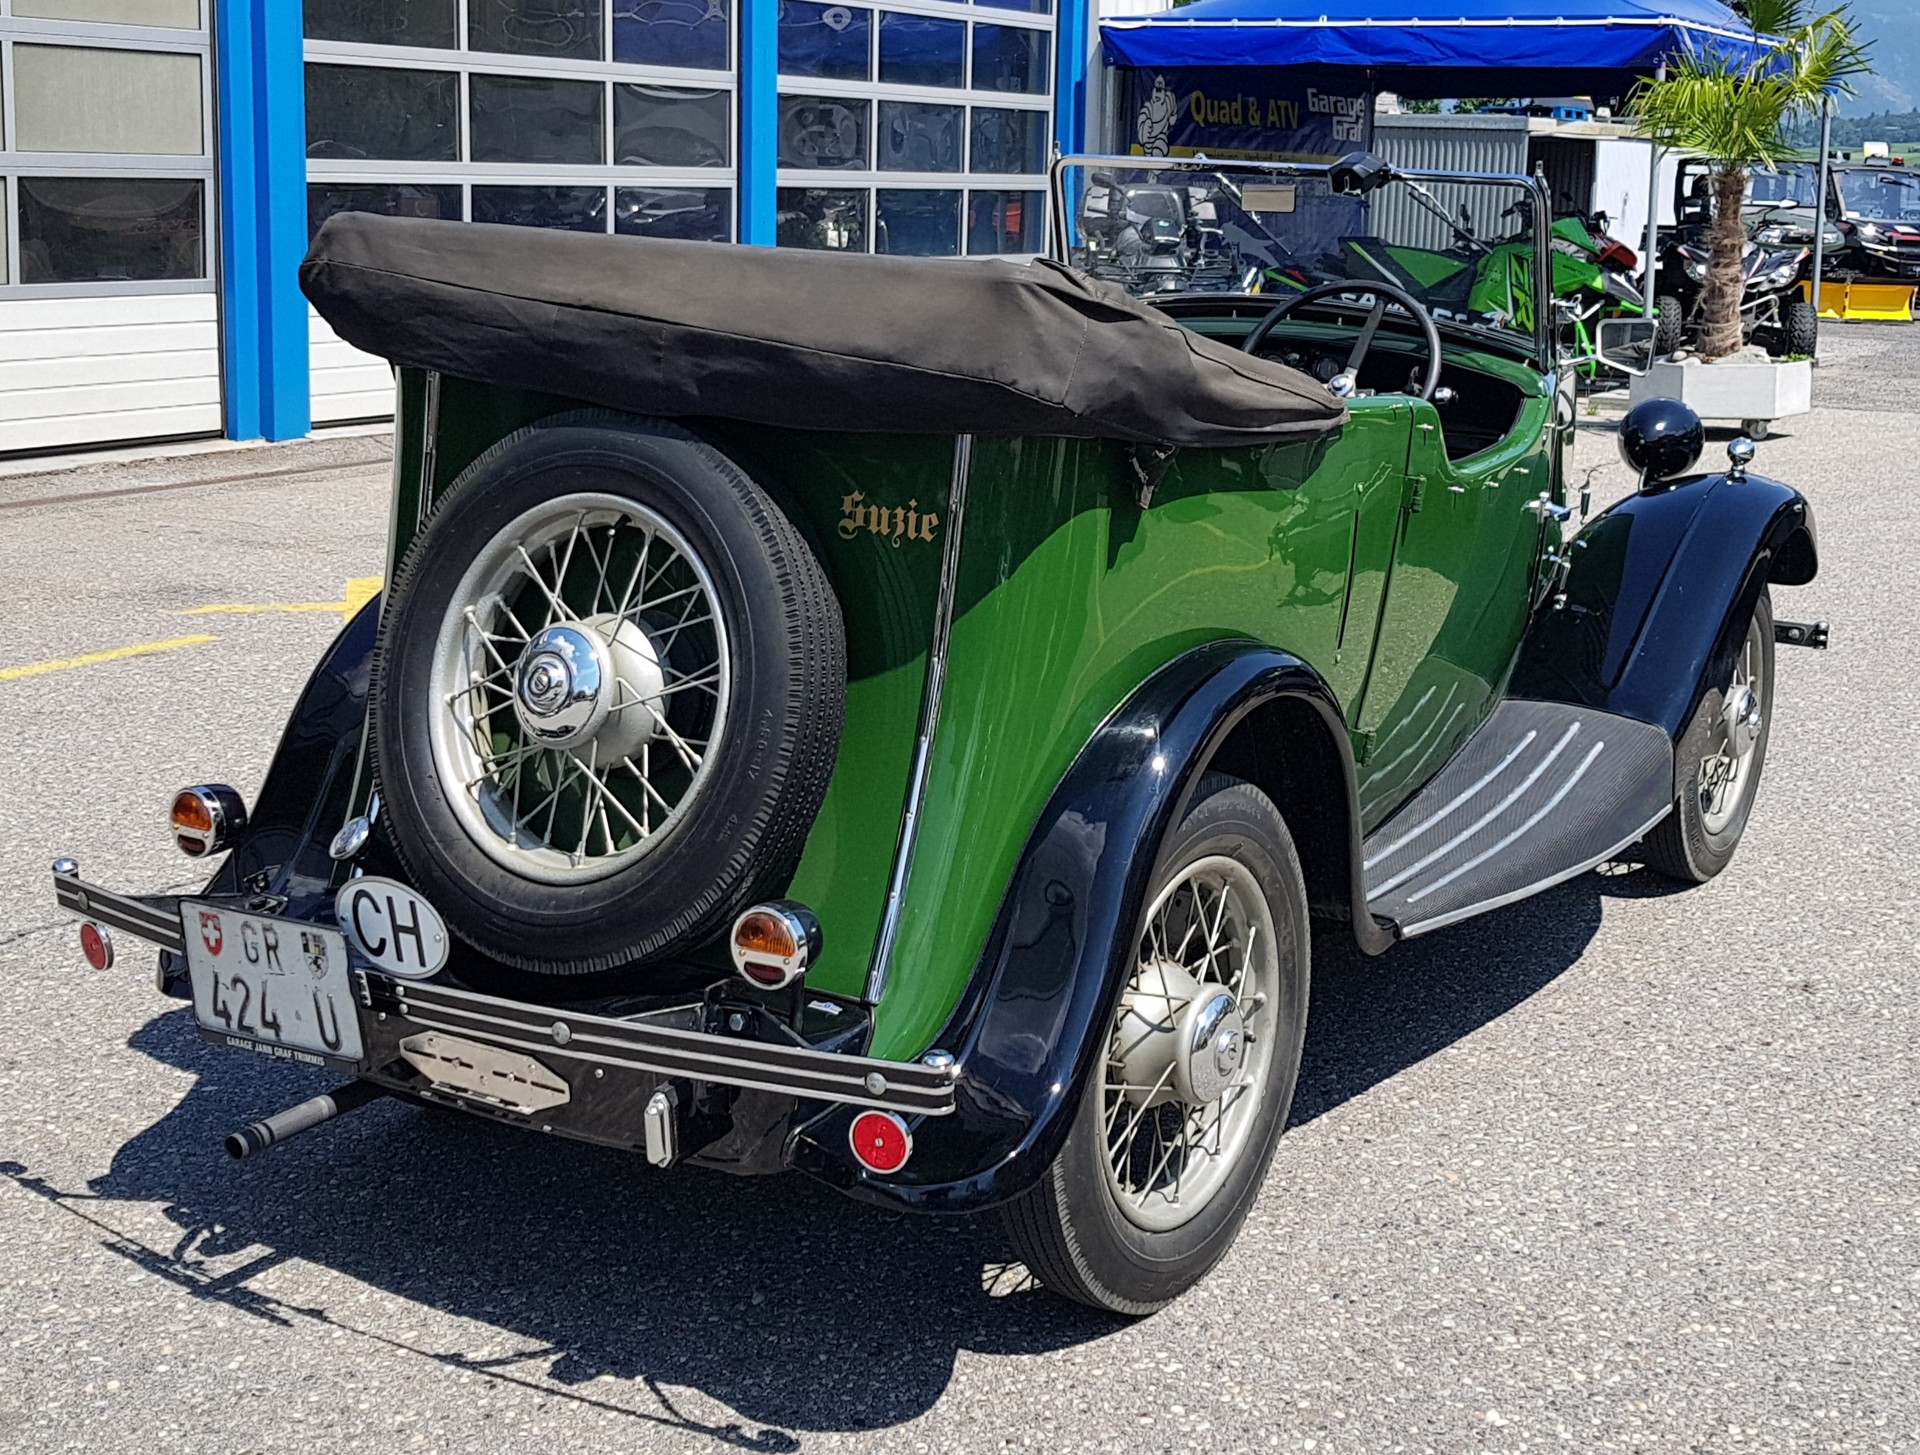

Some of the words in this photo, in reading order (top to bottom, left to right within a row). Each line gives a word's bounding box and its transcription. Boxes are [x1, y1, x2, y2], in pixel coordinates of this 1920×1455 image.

[1190, 90, 1242, 128] Quad
[1248, 96, 1261, 126] &
[1266, 99, 1299, 129] ATV
[1307, 87, 1365, 122] Garage
[1332, 116, 1364, 142] Graf
[837, 489, 940, 549] Suzie
[240, 920, 284, 972] GR
[352, 889, 427, 968] CH
[212, 971, 282, 1042] 424
[312, 988, 342, 1052] U
[226, 1036, 253, 1051] GARAGE
[274, 1047, 293, 1059] GRAF
[293, 1051, 325, 1067] TRIMMIS
